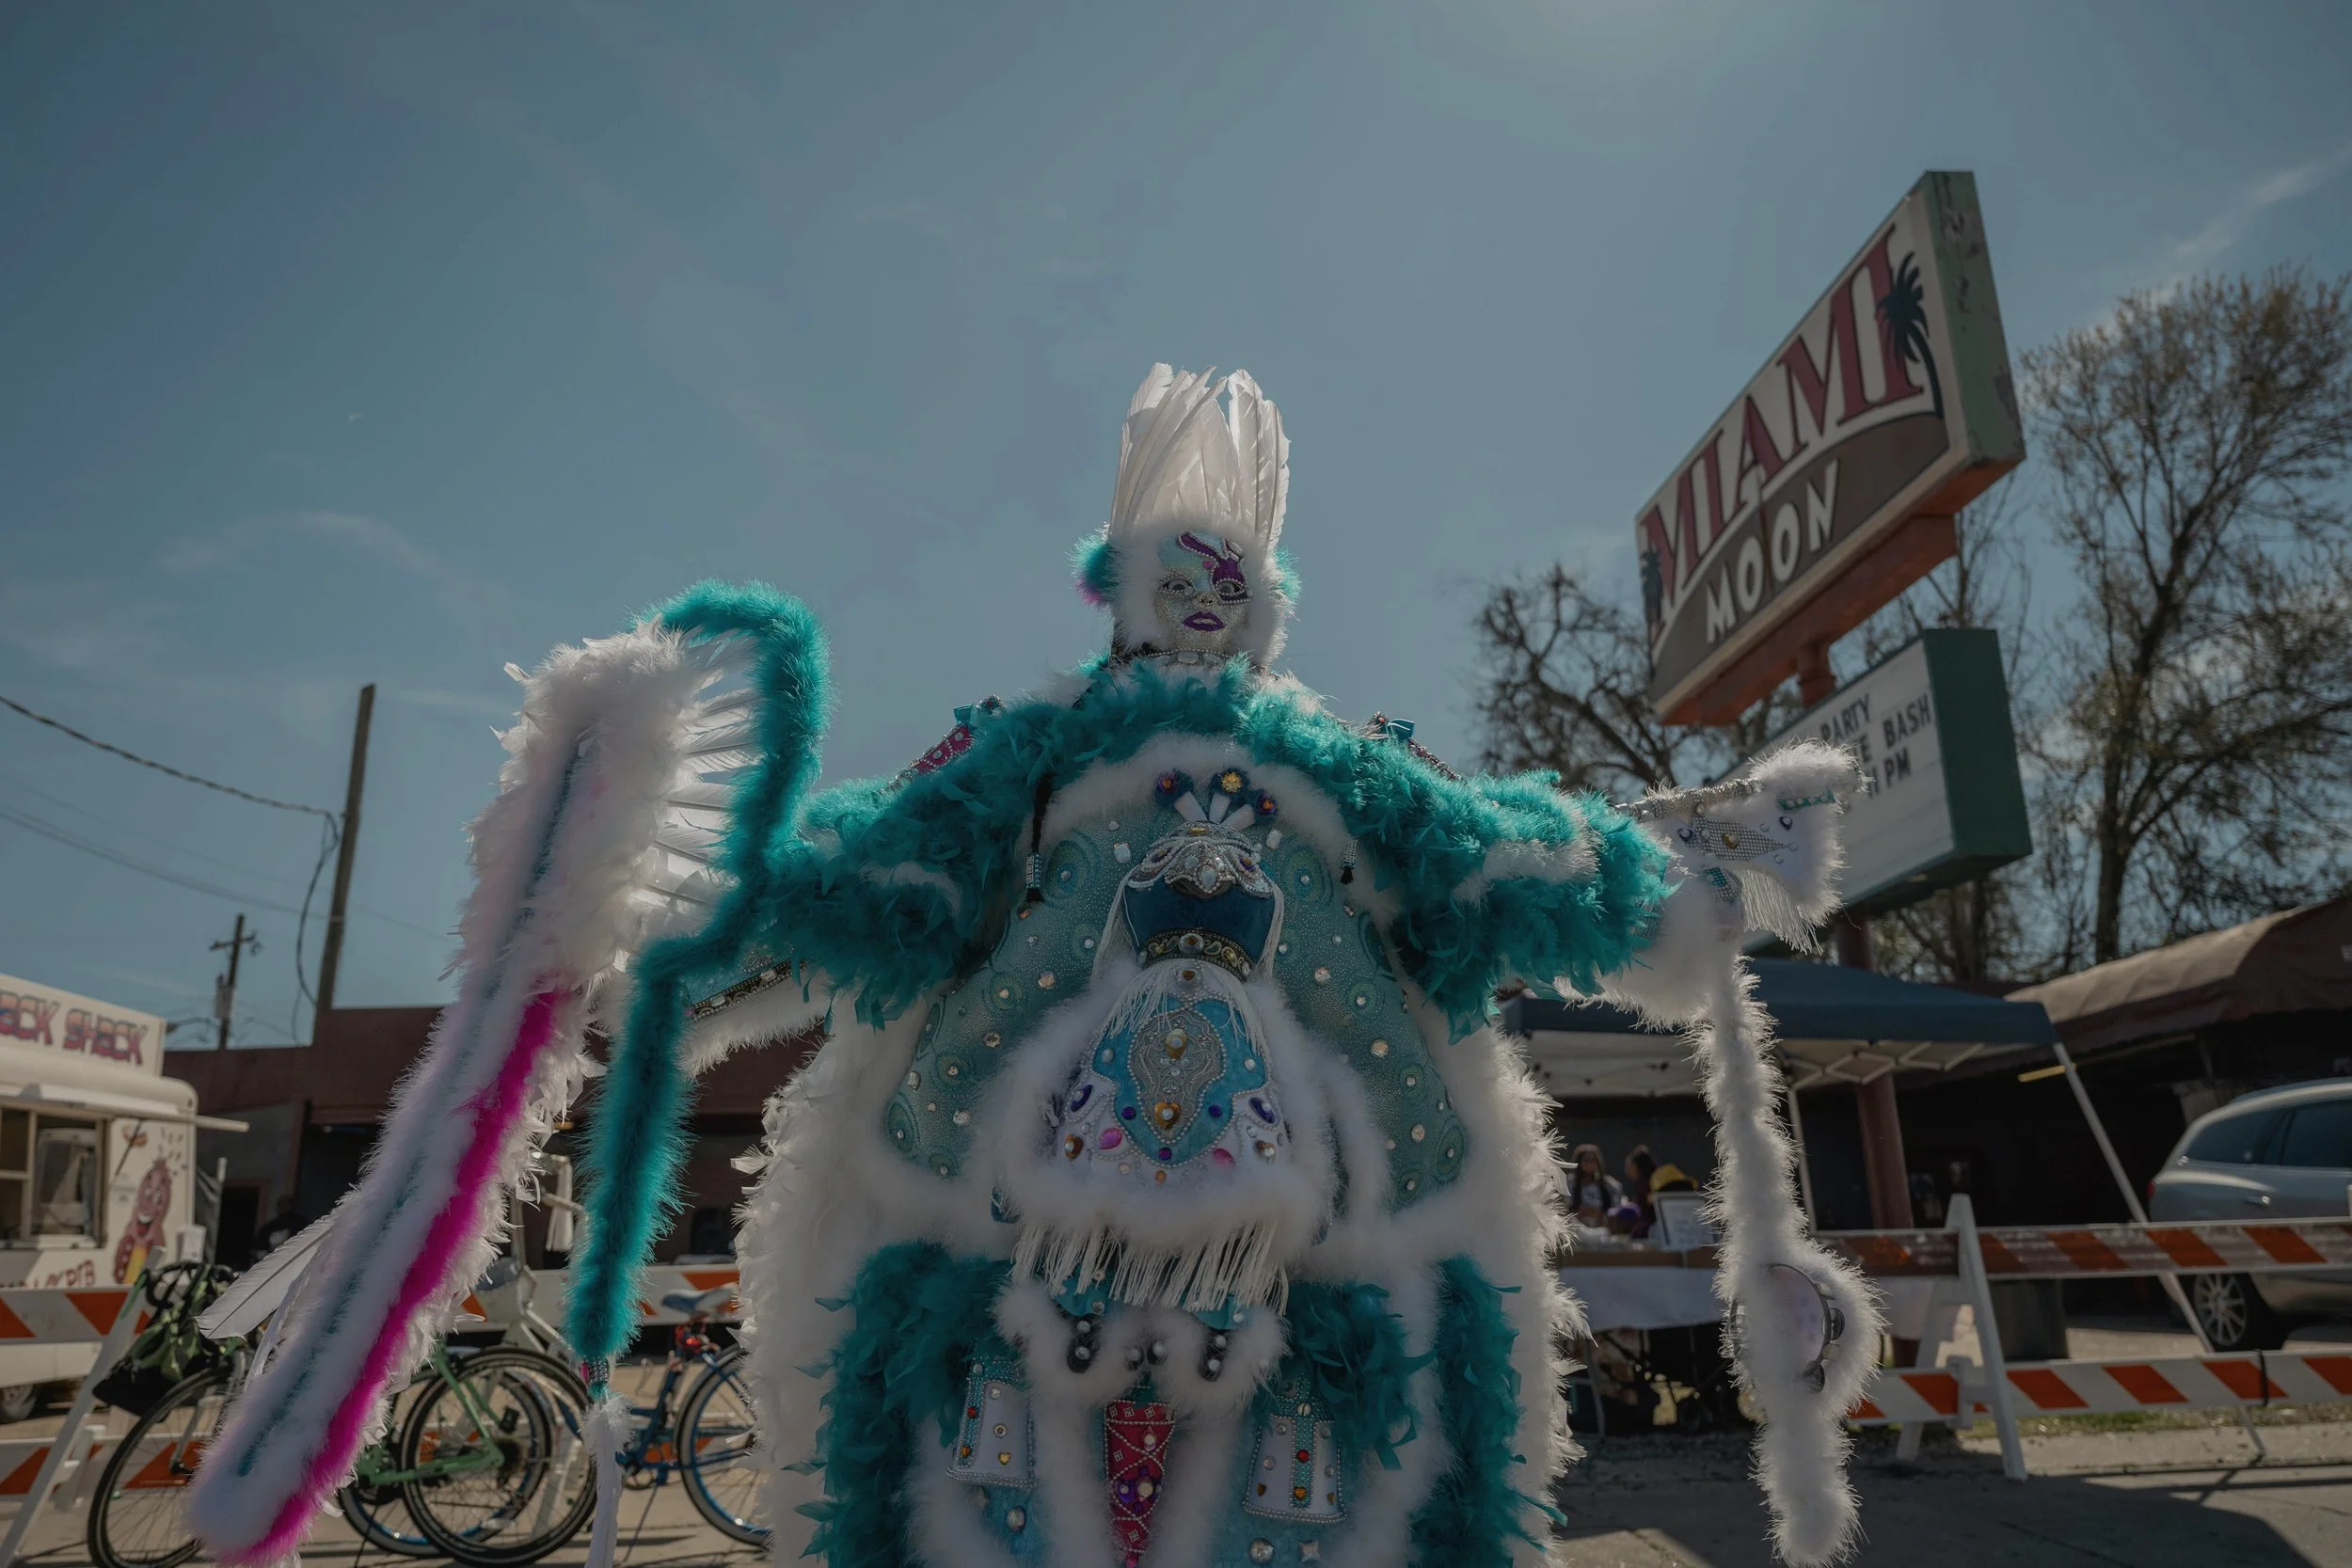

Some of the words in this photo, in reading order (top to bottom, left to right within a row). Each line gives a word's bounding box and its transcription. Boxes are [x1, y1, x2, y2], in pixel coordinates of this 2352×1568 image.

[1639, 222, 1925, 649] MIAMI
[1706, 458, 1840, 644] MOON
[1820, 692, 1871, 743] PARTY
[1883, 692, 1931, 749] BASH
[1884, 747, 1912, 788] PM
[63, 1007, 149, 1066] SHACK
